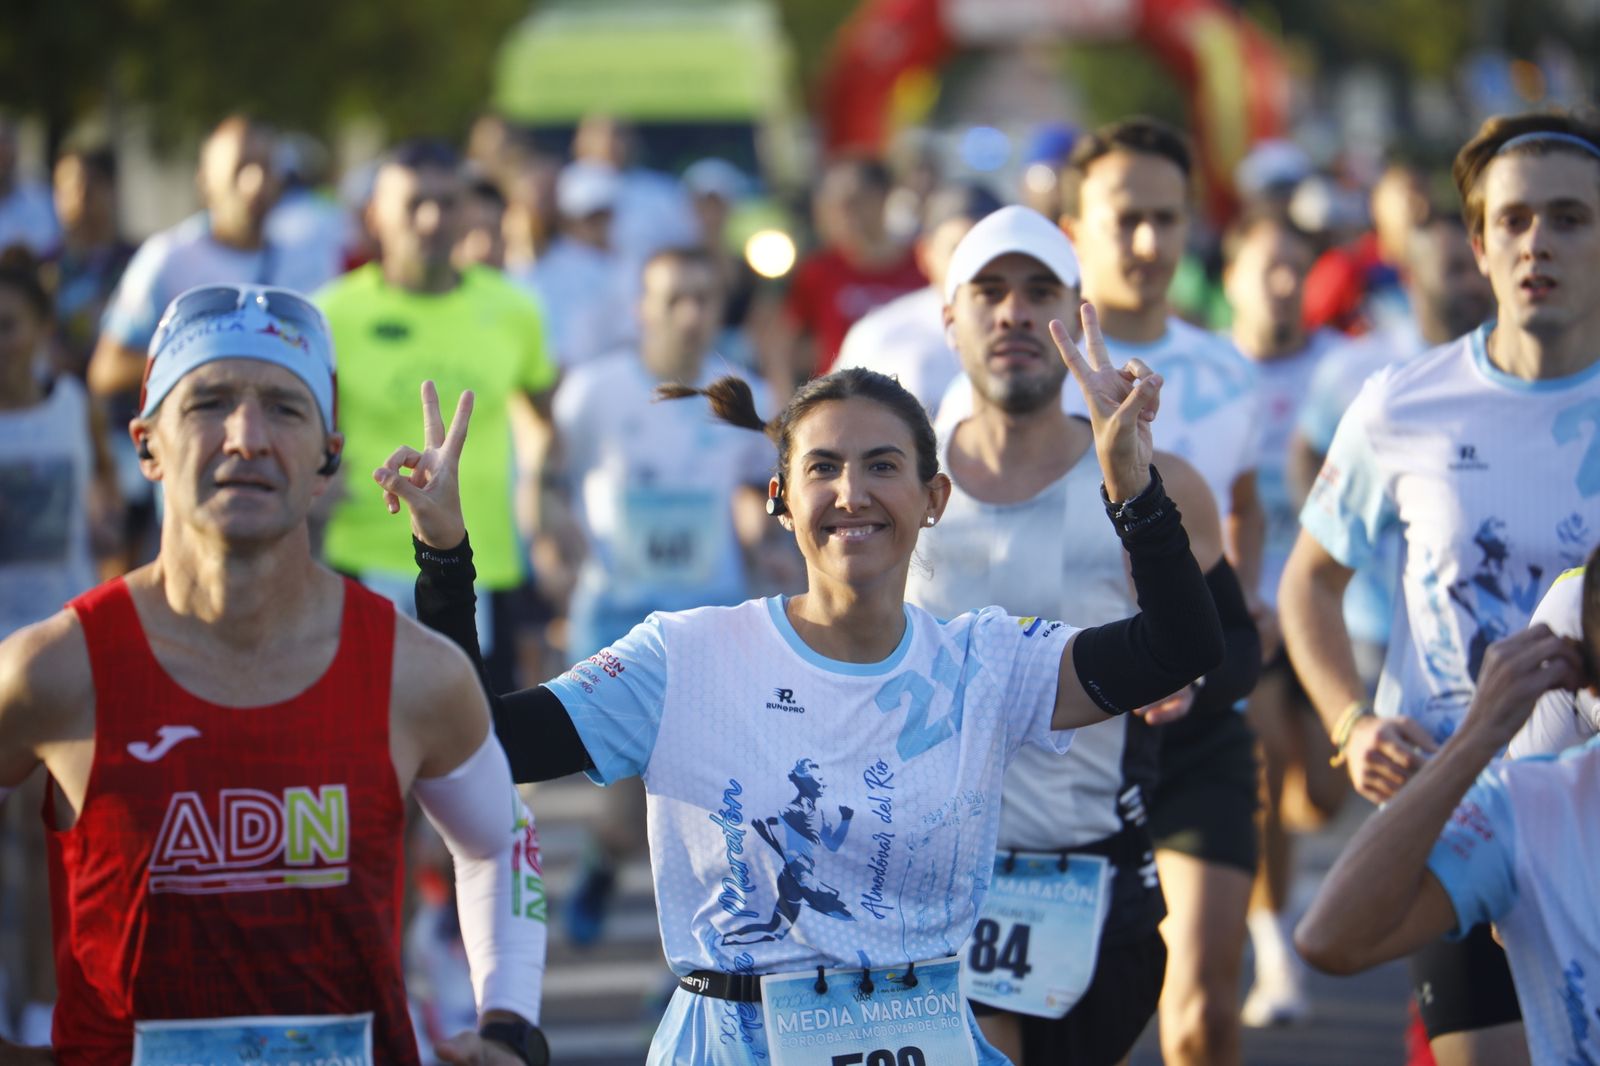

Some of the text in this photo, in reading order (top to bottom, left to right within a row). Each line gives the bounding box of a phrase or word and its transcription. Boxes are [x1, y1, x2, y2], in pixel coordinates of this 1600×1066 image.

[149, 784, 349, 872] ADN
[709, 778, 760, 918] Maratón
[861, 756, 896, 919] Almodóvar del Río
[968, 917, 1032, 980] 84
[776, 1006, 855, 1035] MEDIA
[861, 989, 957, 1024] MARATÓN
[919, 1019, 938, 1032] DEL
[942, 1013, 960, 1028] RÍO
